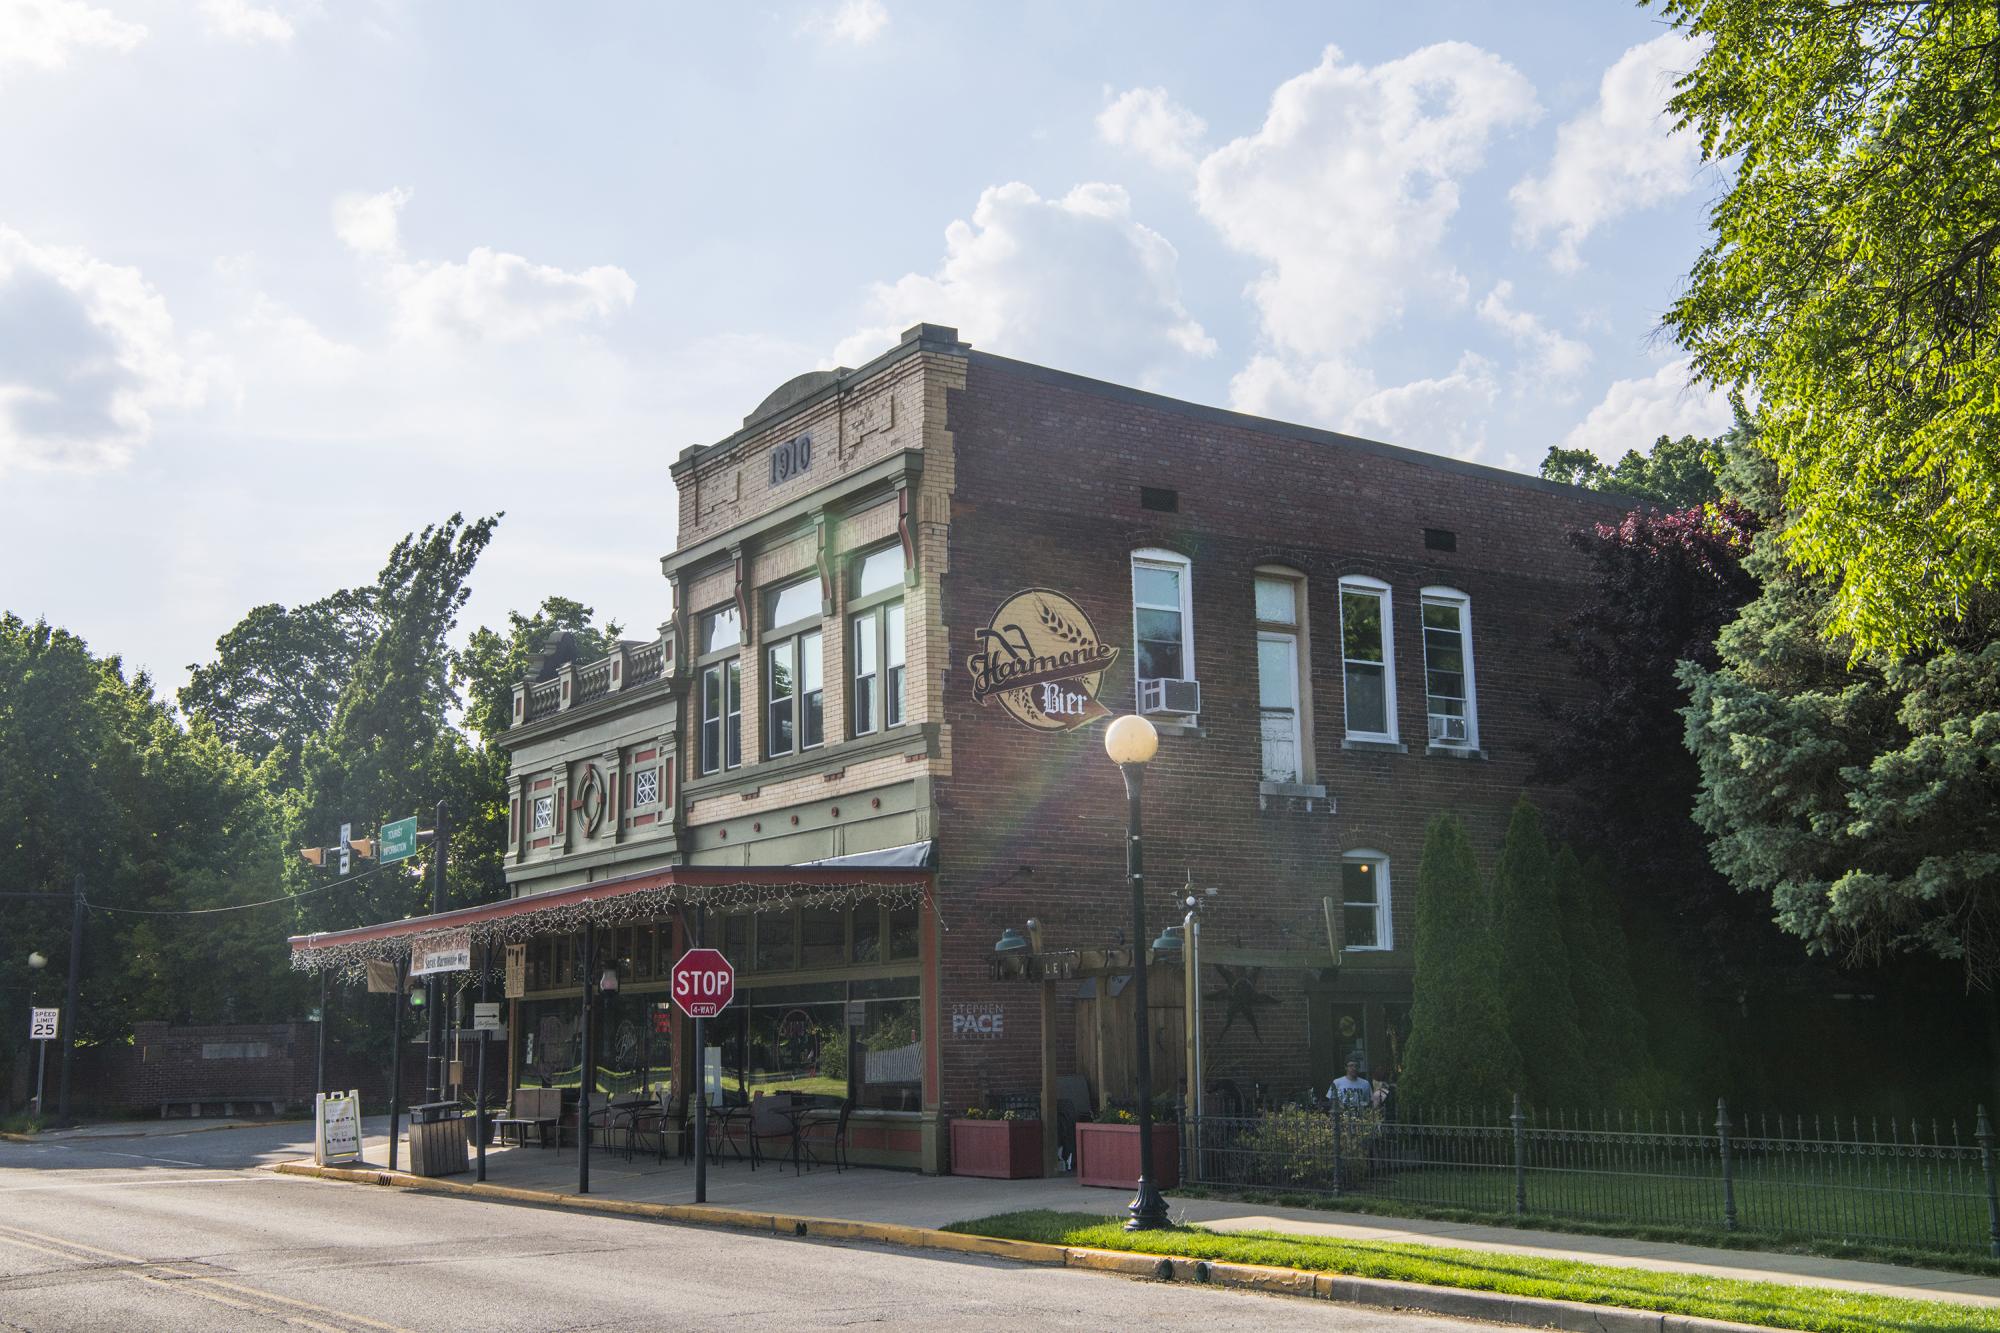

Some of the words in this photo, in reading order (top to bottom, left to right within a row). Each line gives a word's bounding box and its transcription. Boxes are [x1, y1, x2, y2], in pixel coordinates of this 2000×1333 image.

[771, 437, 811, 484] 1910
[970, 640, 1112, 693] Harmonie
[1041, 681, 1088, 715] Bier
[676, 970, 729, 996] STOP
[693, 1006, 714, 1014] 4-WAY
[952, 1004, 1004, 1014] STEPHEN
[34, 1024, 55, 1035] 25
[952, 1014, 1003, 1032] PACE
